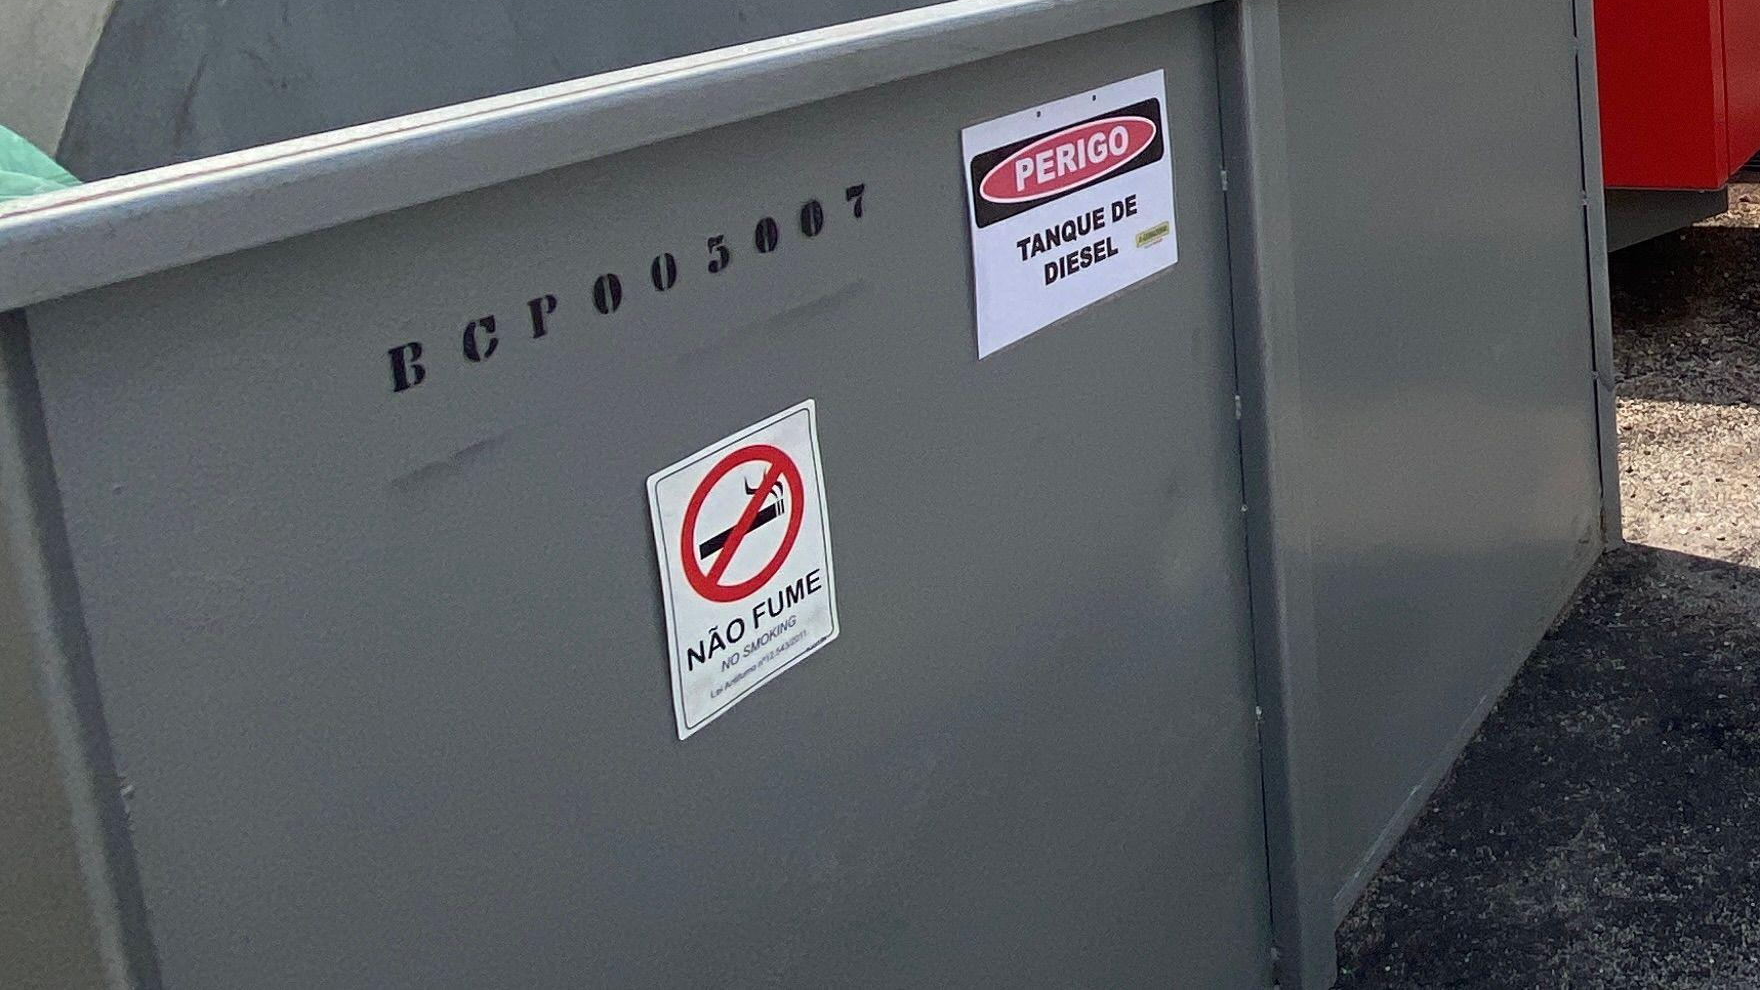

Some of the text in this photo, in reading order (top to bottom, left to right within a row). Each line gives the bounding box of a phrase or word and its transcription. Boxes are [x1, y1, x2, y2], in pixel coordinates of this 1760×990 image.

[1014, 125, 1129, 192] PERIGO
[1016, 207, 1106, 261] TANQUE
[1111, 194, 1138, 223] DE
[1044, 236, 1119, 286] DIESEL
[387, 183, 866, 393] BCP005007
[686, 568, 822, 671] NÃO FUME
[721, 652, 740, 672] NO
[743, 614, 797, 658] SMOKING
